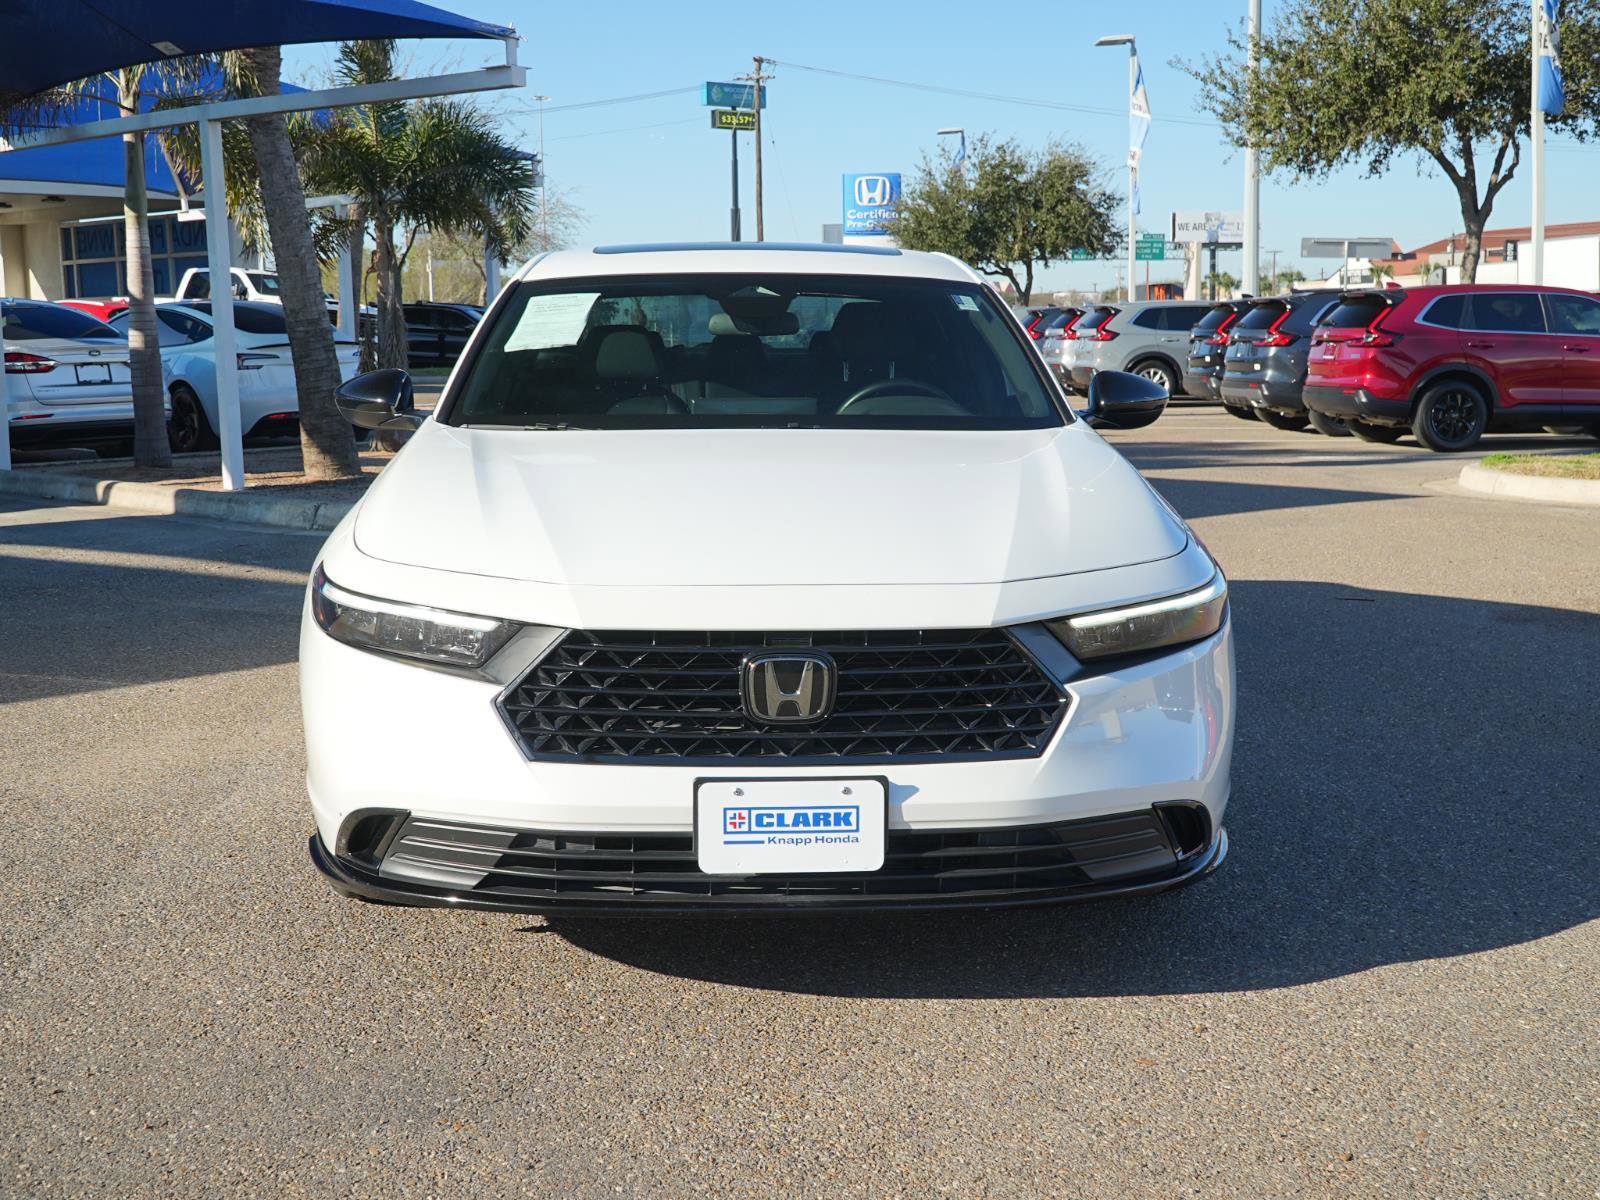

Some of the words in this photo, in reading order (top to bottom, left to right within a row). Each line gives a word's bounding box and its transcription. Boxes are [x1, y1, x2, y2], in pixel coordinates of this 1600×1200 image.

[1177, 223, 1190, 231] WE
[755, 811, 853, 828] CLARK
[767, 836, 812, 846] Knapp
[815, 834, 859, 844] Honda
